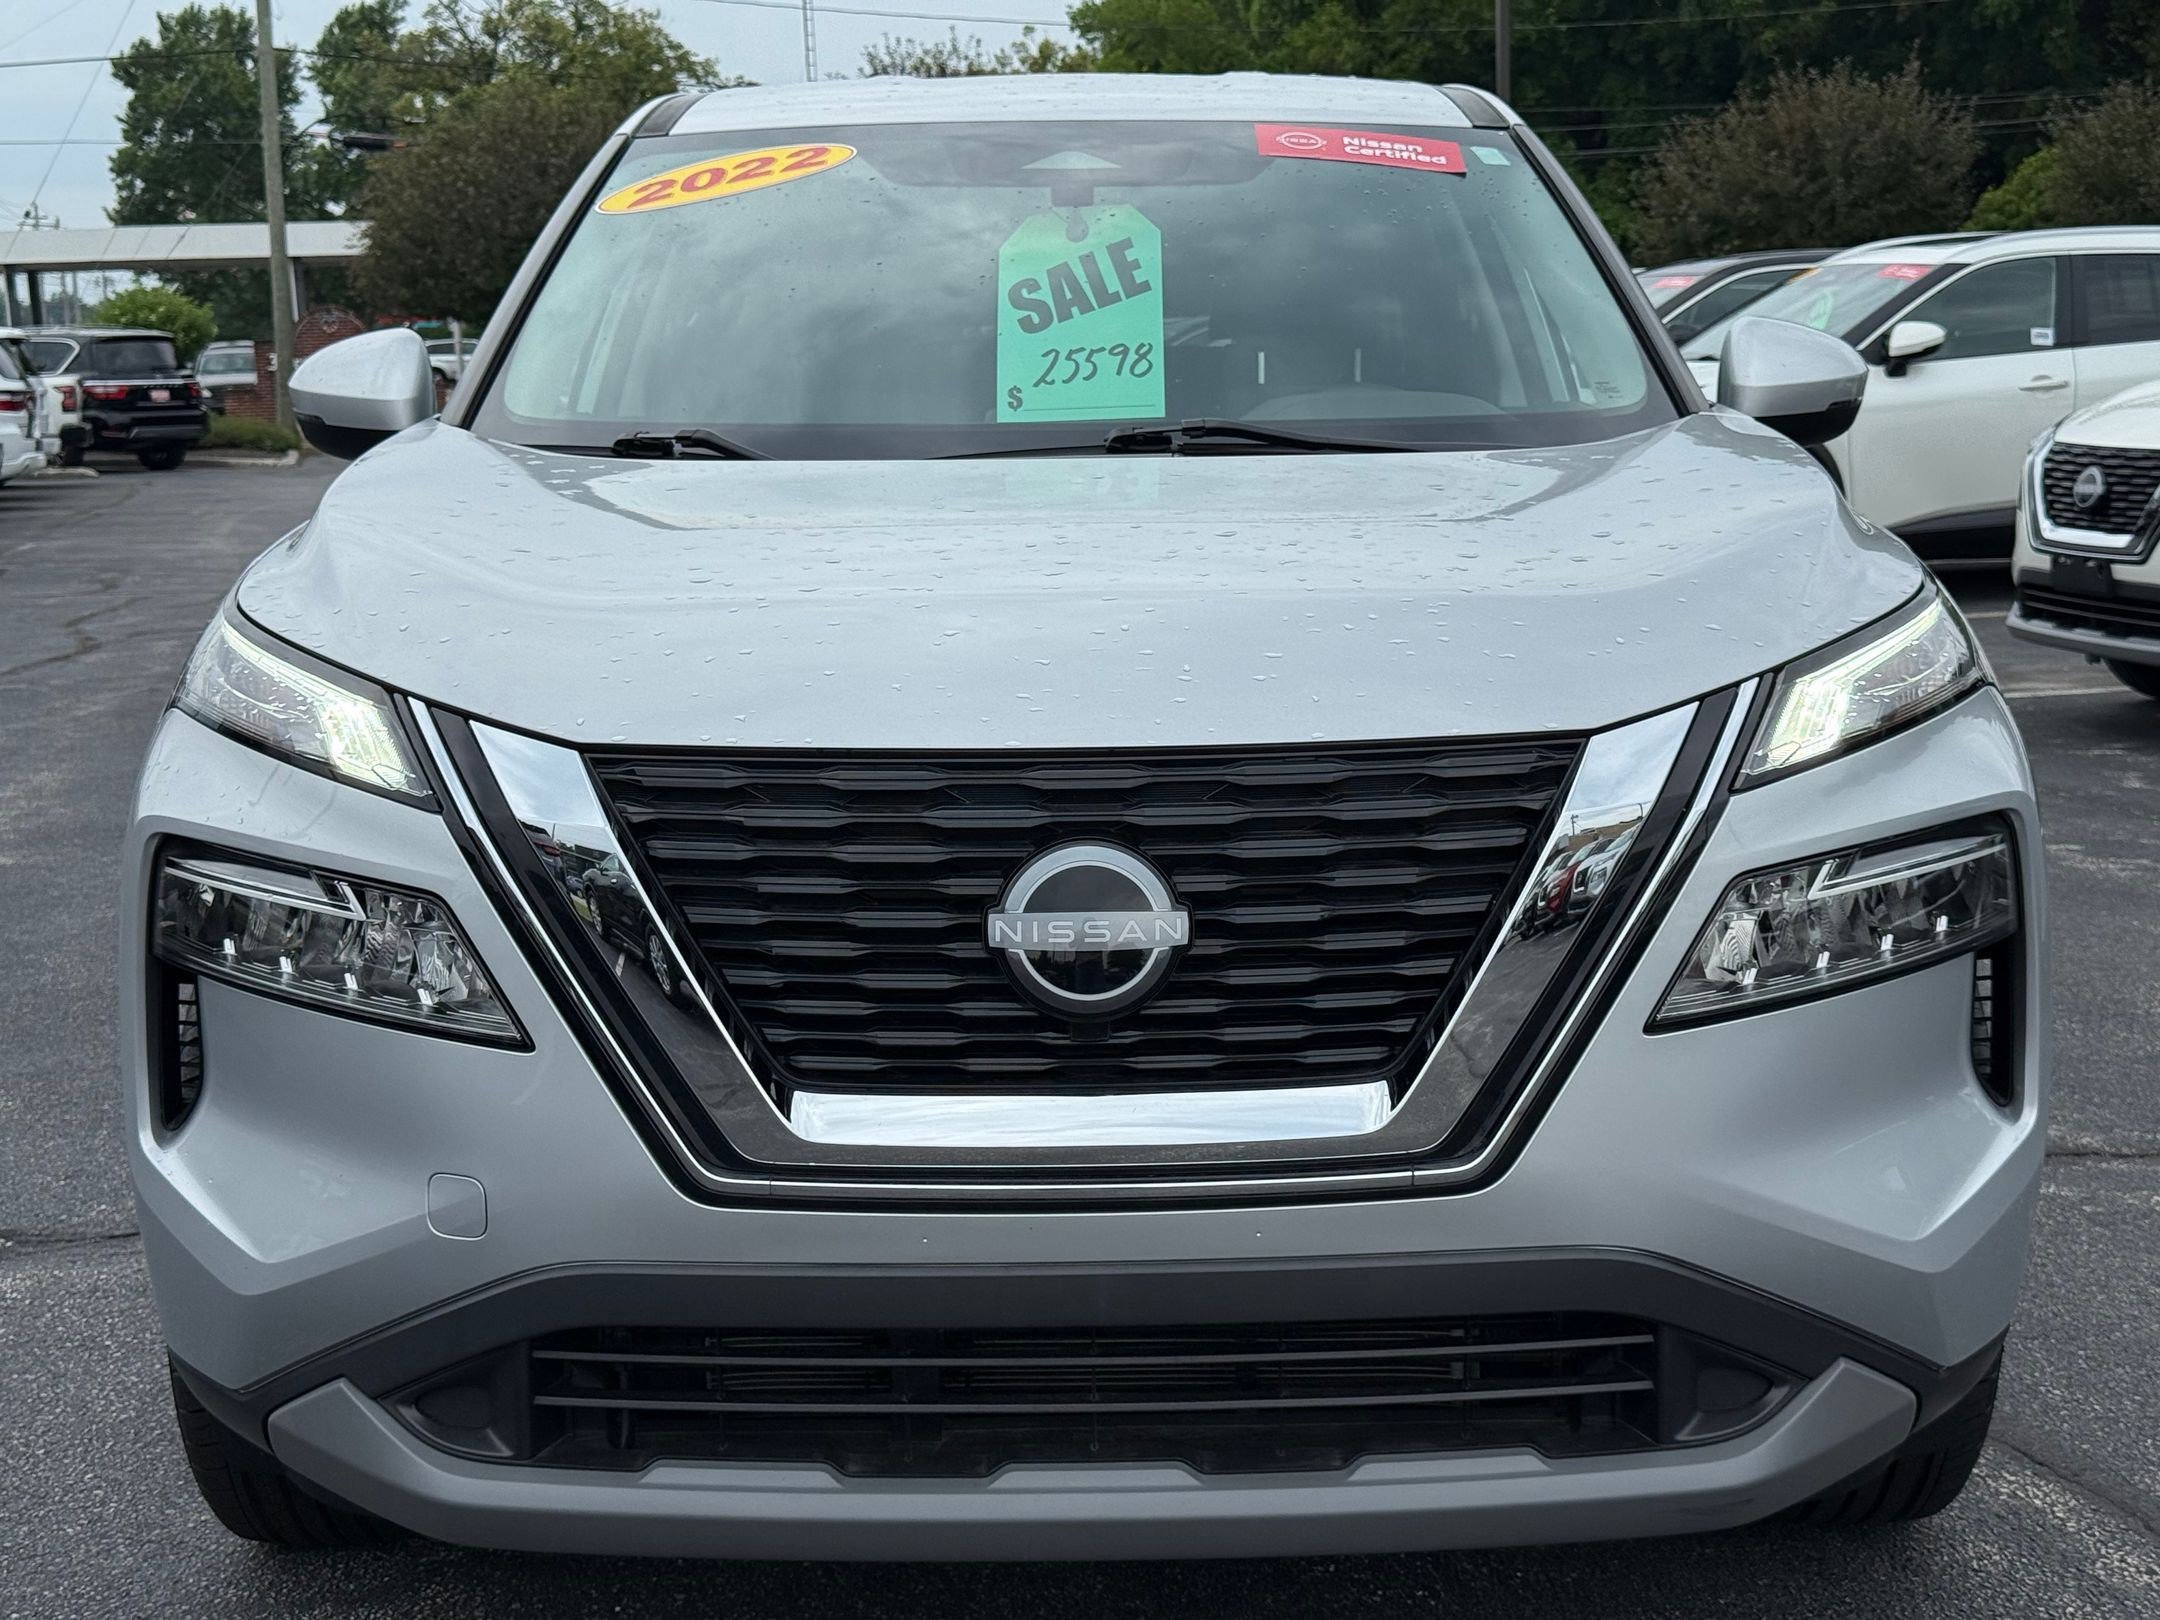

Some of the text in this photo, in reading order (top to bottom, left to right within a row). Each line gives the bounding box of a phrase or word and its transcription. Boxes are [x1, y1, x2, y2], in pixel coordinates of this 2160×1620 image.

[1343, 136, 1422, 153] Nissan
[1344, 145, 1447, 165] Certified
[627, 147, 831, 209] 2022
[1007, 236, 1152, 334] SALE
[1007, 342, 1154, 412] $ 25598
[995, 918, 1182, 943] NISSAN
